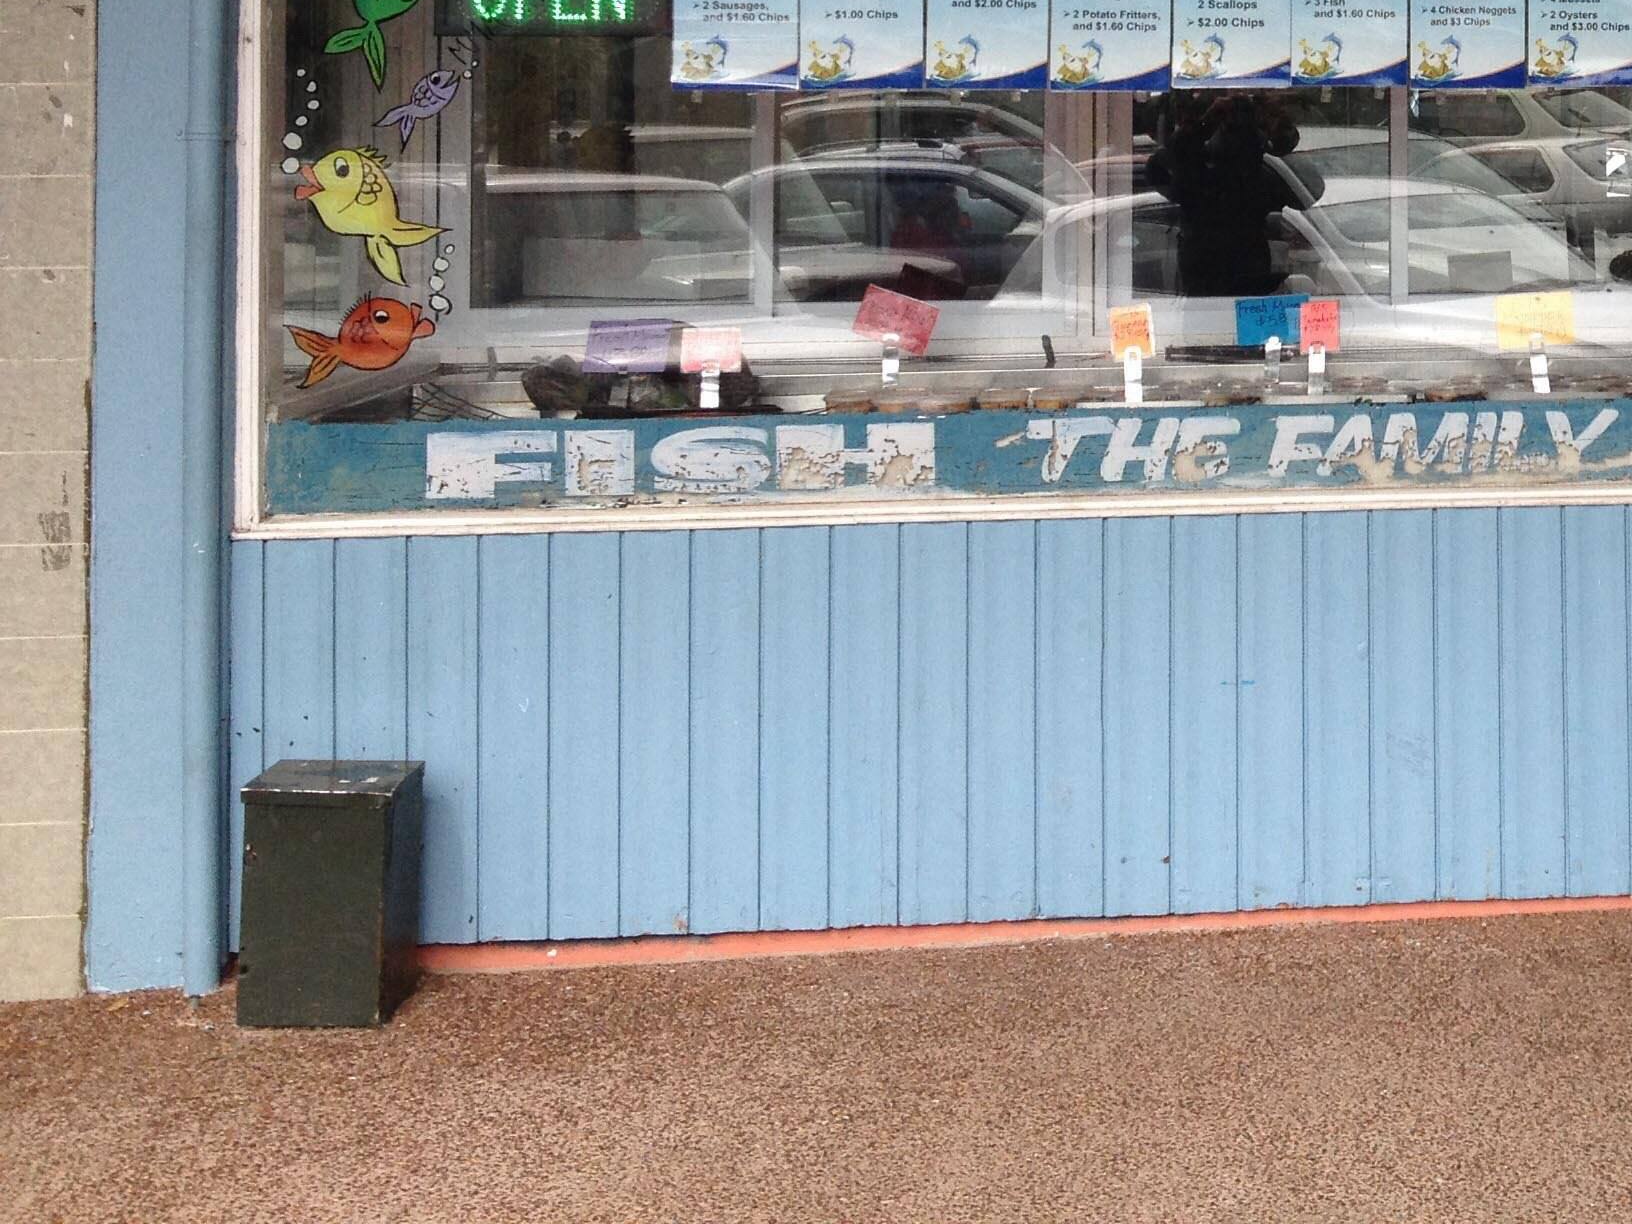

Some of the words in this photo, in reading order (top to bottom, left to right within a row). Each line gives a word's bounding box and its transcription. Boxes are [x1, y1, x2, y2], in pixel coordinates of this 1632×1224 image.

[951, 0, 971, 7] and
[1005, 0, 1037, 10] Chips
[1207, 0, 1258, 10] Scallops
[1438, 6, 1476, 14] Chicken
[702, 13, 723, 22] and
[758, 12, 789, 24] Chips
[866, 9, 898, 21] Chips
[1082, 10, 1116, 19] Potato
[1314, 9, 1334, 18] and
[1366, 9, 1396, 20] Chips
[1558, 10, 1598, 20] Oysters
[1072, 22, 1093, 31] and
[1126, 22, 1157, 33] Chips
[1231, 18, 1265, 29] Chips
[1430, 17, 1447, 26] and
[1450, 17, 1461, 27] $3
[1463, 17, 1490, 27] Chips
[1549, 22, 1569, 31] and
[1600, 22, 1630, 33] Chips
[994, 415, 1241, 482] THE
[1268, 409, 1617, 476] FAMILY
[425, 422, 936, 499] FISH
